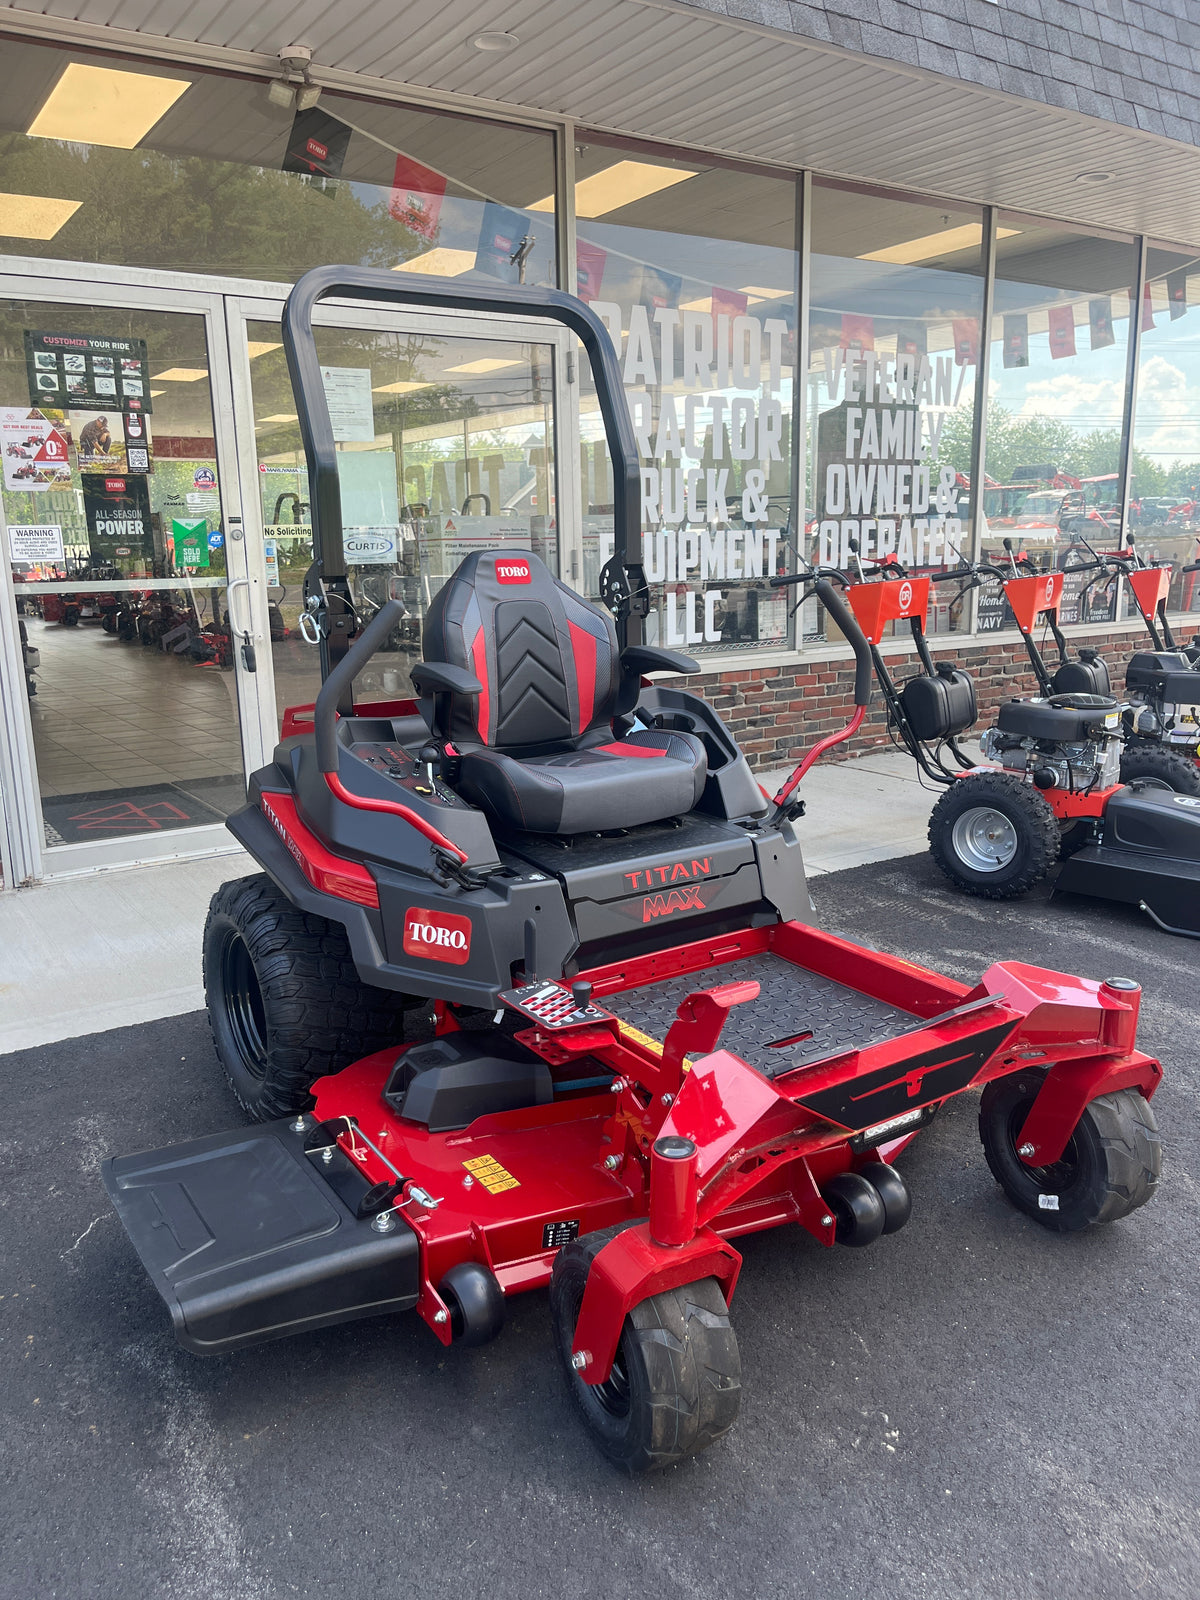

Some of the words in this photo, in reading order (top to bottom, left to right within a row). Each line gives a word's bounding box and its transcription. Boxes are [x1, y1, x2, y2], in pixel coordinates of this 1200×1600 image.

[308, 142, 327, 156] TORO
[43, 336, 88, 347] CUSTOMIZE
[89, 340, 111, 349] YOUR
[112, 342, 130, 350] RIDE
[624, 390, 783, 461] RACTOR
[845, 407, 945, 460] FAMILY
[640, 467, 729, 523] RUCK
[742, 468, 769, 523] &
[826, 464, 930, 515] OWNED
[936, 466, 958, 514] &
[95, 509, 143, 519] ALL-SEASON
[15, 529, 54, 537] WARNING
[95, 520, 145, 536] POWER
[264, 528, 275, 536] No
[277, 526, 312, 537] Soliciting
[210, 534, 222, 542] ADT
[819, 518, 962, 571] OPERATED
[183, 547, 200, 556] SOLD
[347, 541, 386, 551] CURTIS
[183, 555, 200, 563] HERE
[600, 529, 782, 583] EUIPMENT
[497, 566, 529, 578] TORO
[979, 595, 1005, 606] Home
[1062, 590, 1080, 601] ome
[667, 590, 722, 646] LLC
[977, 616, 1003, 629] NAVY
[263, 798, 286, 840] TITAN
[624, 857, 711, 889] TITAN
[642, 885, 706, 923] MAX
